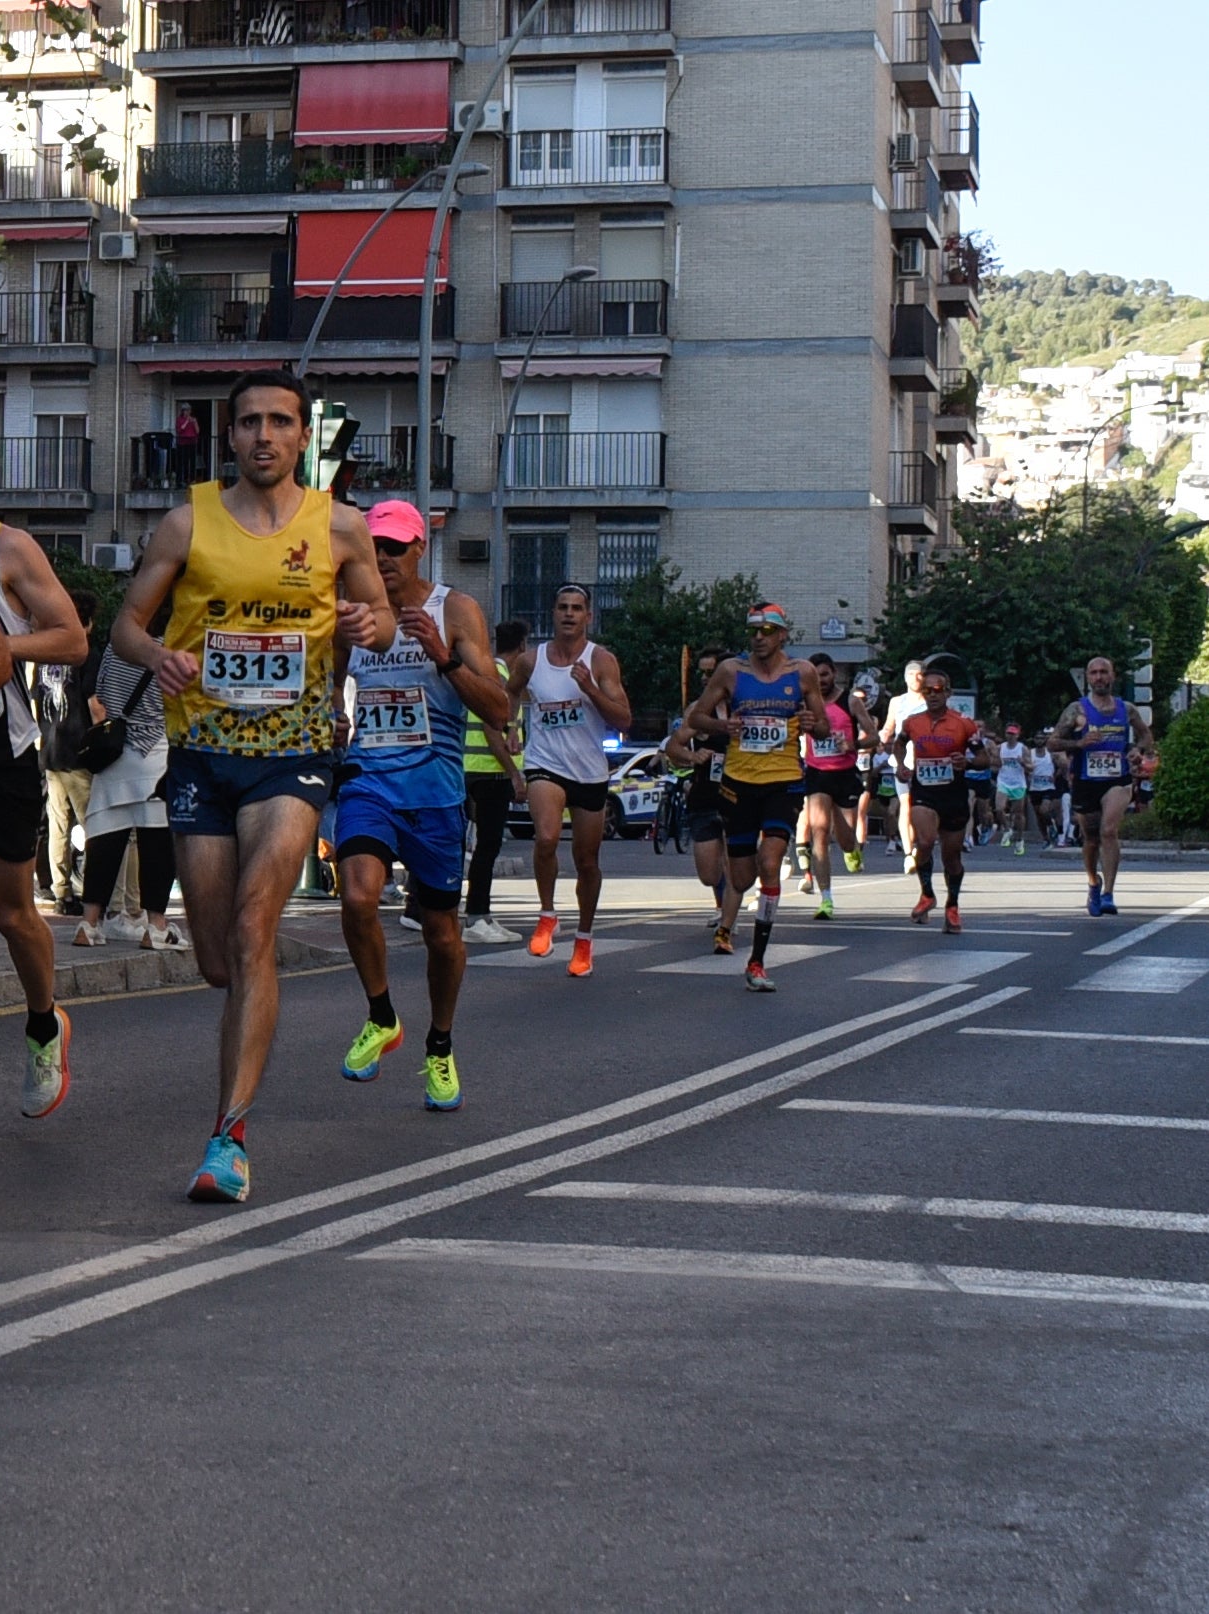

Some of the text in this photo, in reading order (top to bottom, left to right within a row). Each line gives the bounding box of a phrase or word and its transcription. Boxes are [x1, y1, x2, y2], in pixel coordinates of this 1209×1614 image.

[240, 600, 312, 623] Vigilsa
[210, 635, 224, 649] 40
[208, 652, 290, 681] 3313
[357, 705, 416, 728] 2175
[541, 709, 579, 725] 4514
[742, 727, 780, 741] 2980
[1089, 758, 1117, 769] 2654
[919, 766, 947, 778] 5117
